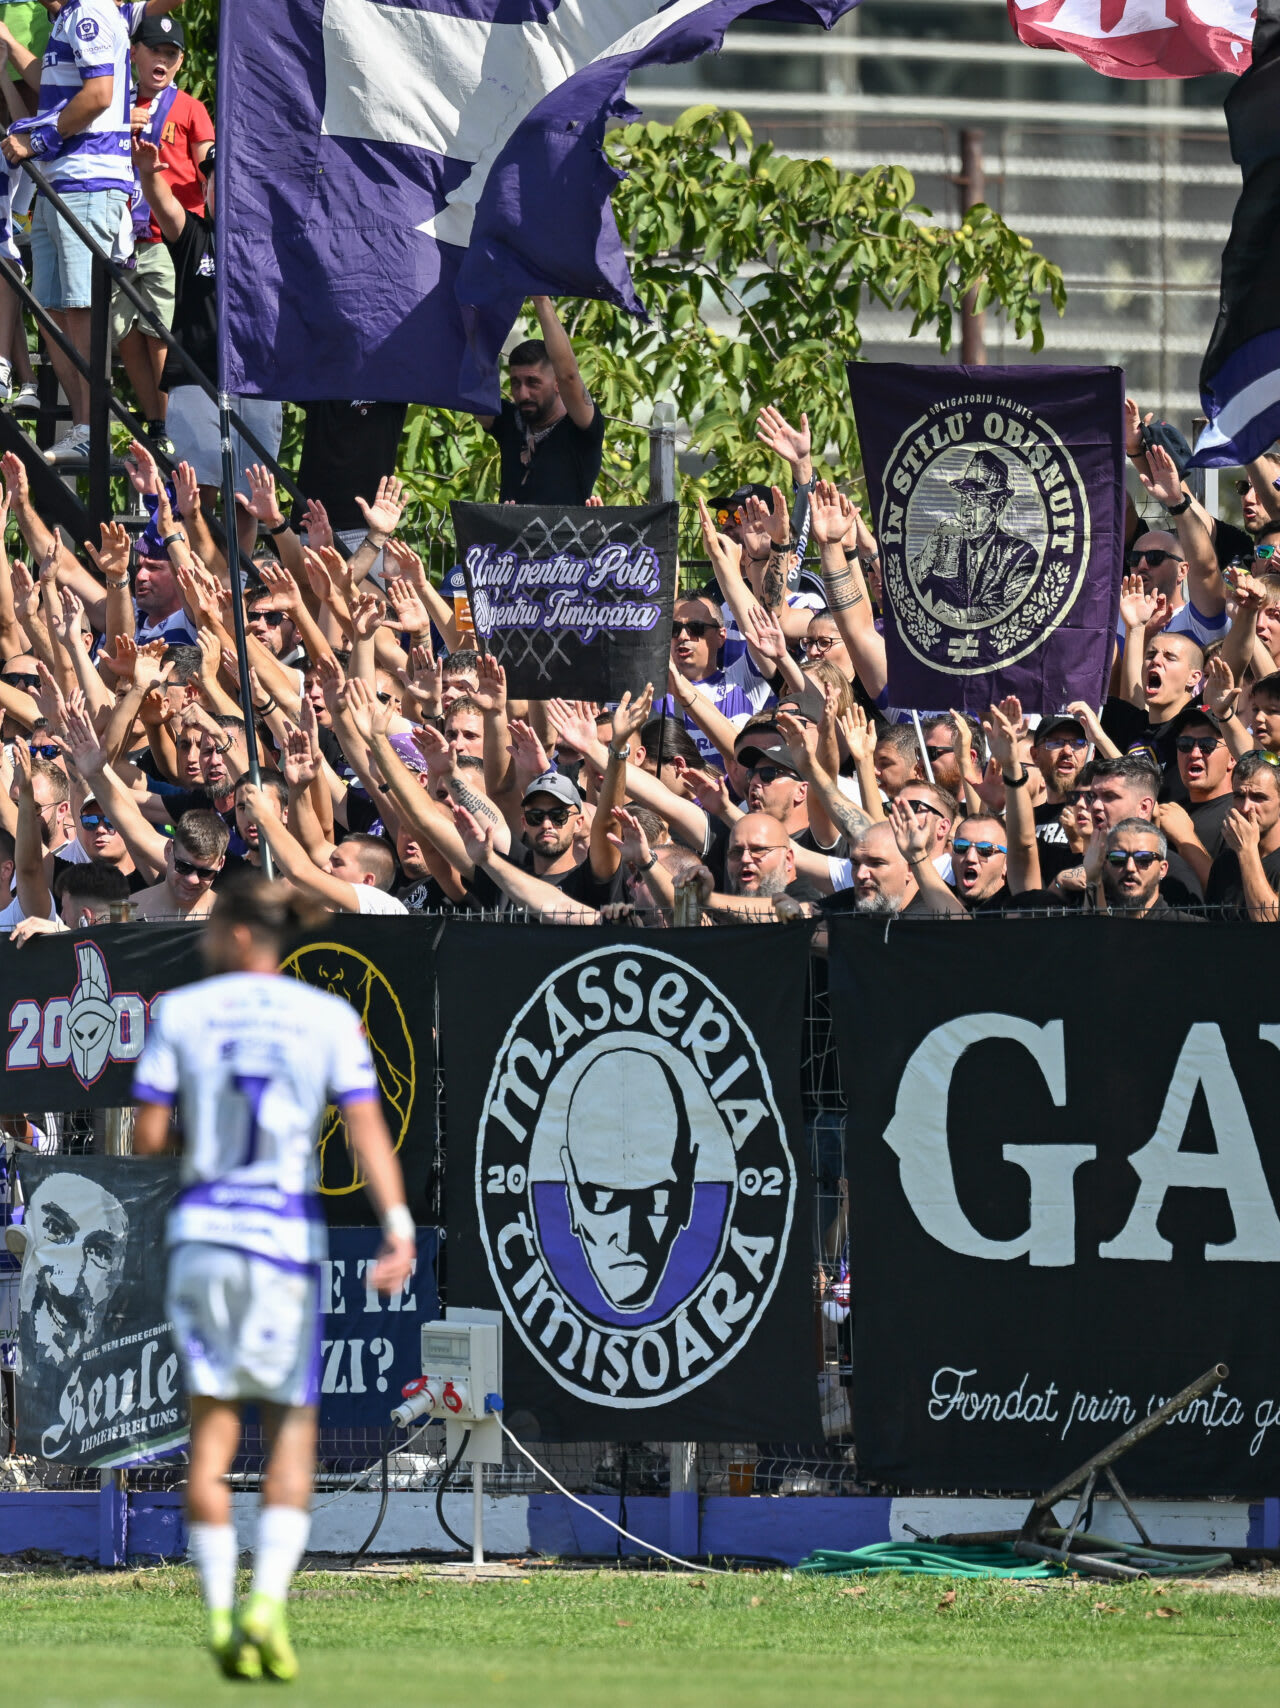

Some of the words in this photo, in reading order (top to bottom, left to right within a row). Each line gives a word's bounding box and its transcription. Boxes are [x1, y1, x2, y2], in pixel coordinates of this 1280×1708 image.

[512, 552, 586, 595] pentru
[587, 545, 659, 593] Poli,
[487, 597, 541, 635] pentru
[543, 589, 657, 640] Timișoara
[882, 1012, 1280, 1266] GA
[738, 1166, 783, 1196] 02
[316, 1337, 394, 1394] ZI?
[927, 1366, 1059, 1421] Fondat
[1061, 1389, 1136, 1441] prin
[80, 1426, 119, 1454] IMMER
[118, 1415, 149, 1439] BEI
[149, 1406, 179, 1429] UNS
